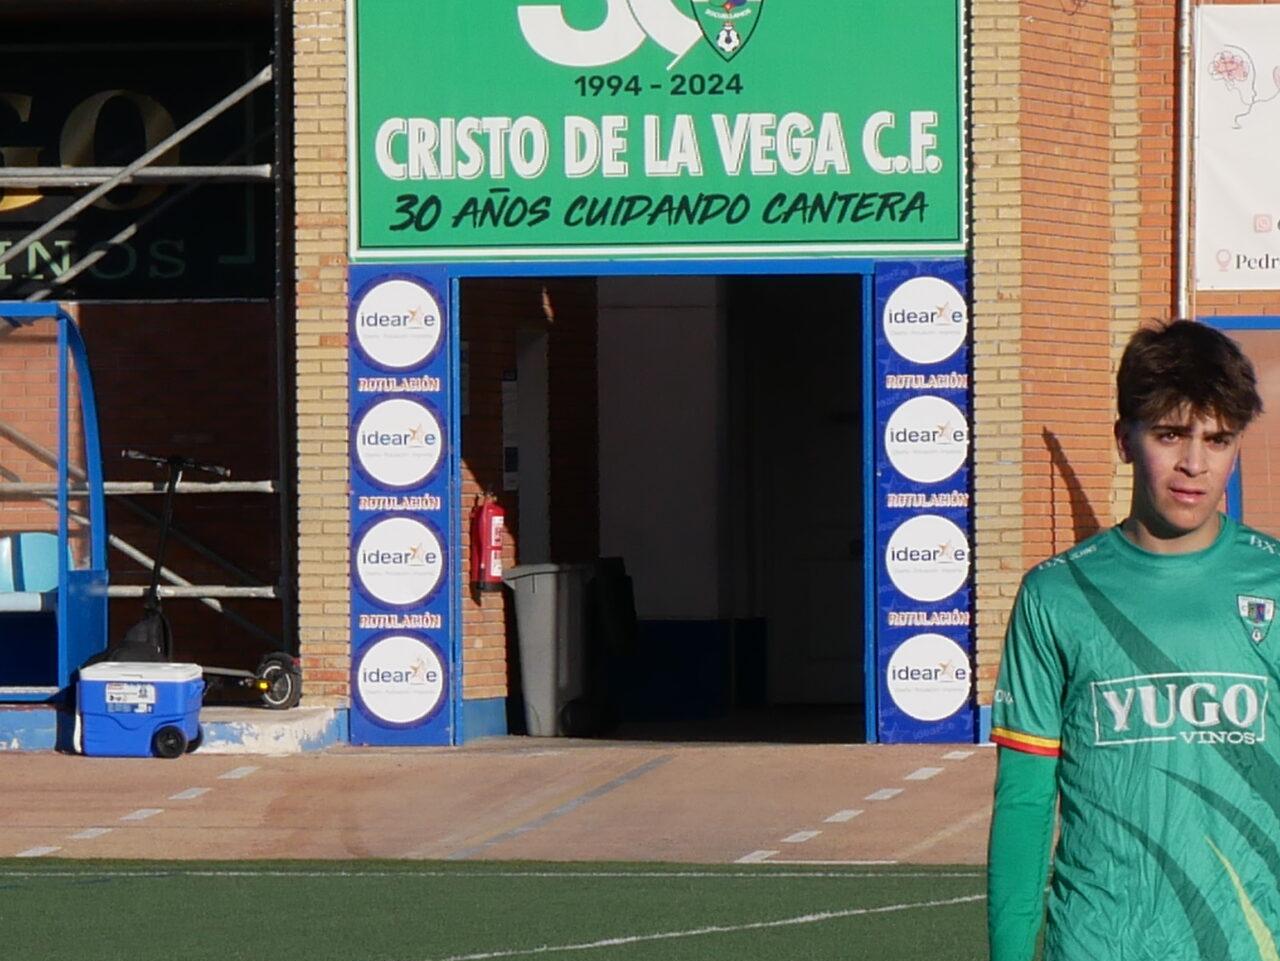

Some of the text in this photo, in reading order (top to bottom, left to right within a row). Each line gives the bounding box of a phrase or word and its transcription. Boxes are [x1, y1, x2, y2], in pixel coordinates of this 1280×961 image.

[574, 75, 641, 97] 1994
[670, 74, 743, 95] 2024
[375, 111, 942, 179] CRISTO DE LA VEGA C.F.
[390, 187, 929, 232] 30 AÑOS CUIDANDO CANTERA
[1102, 682, 1258, 732] YUGO
[1179, 730, 1256, 745] VINOS
